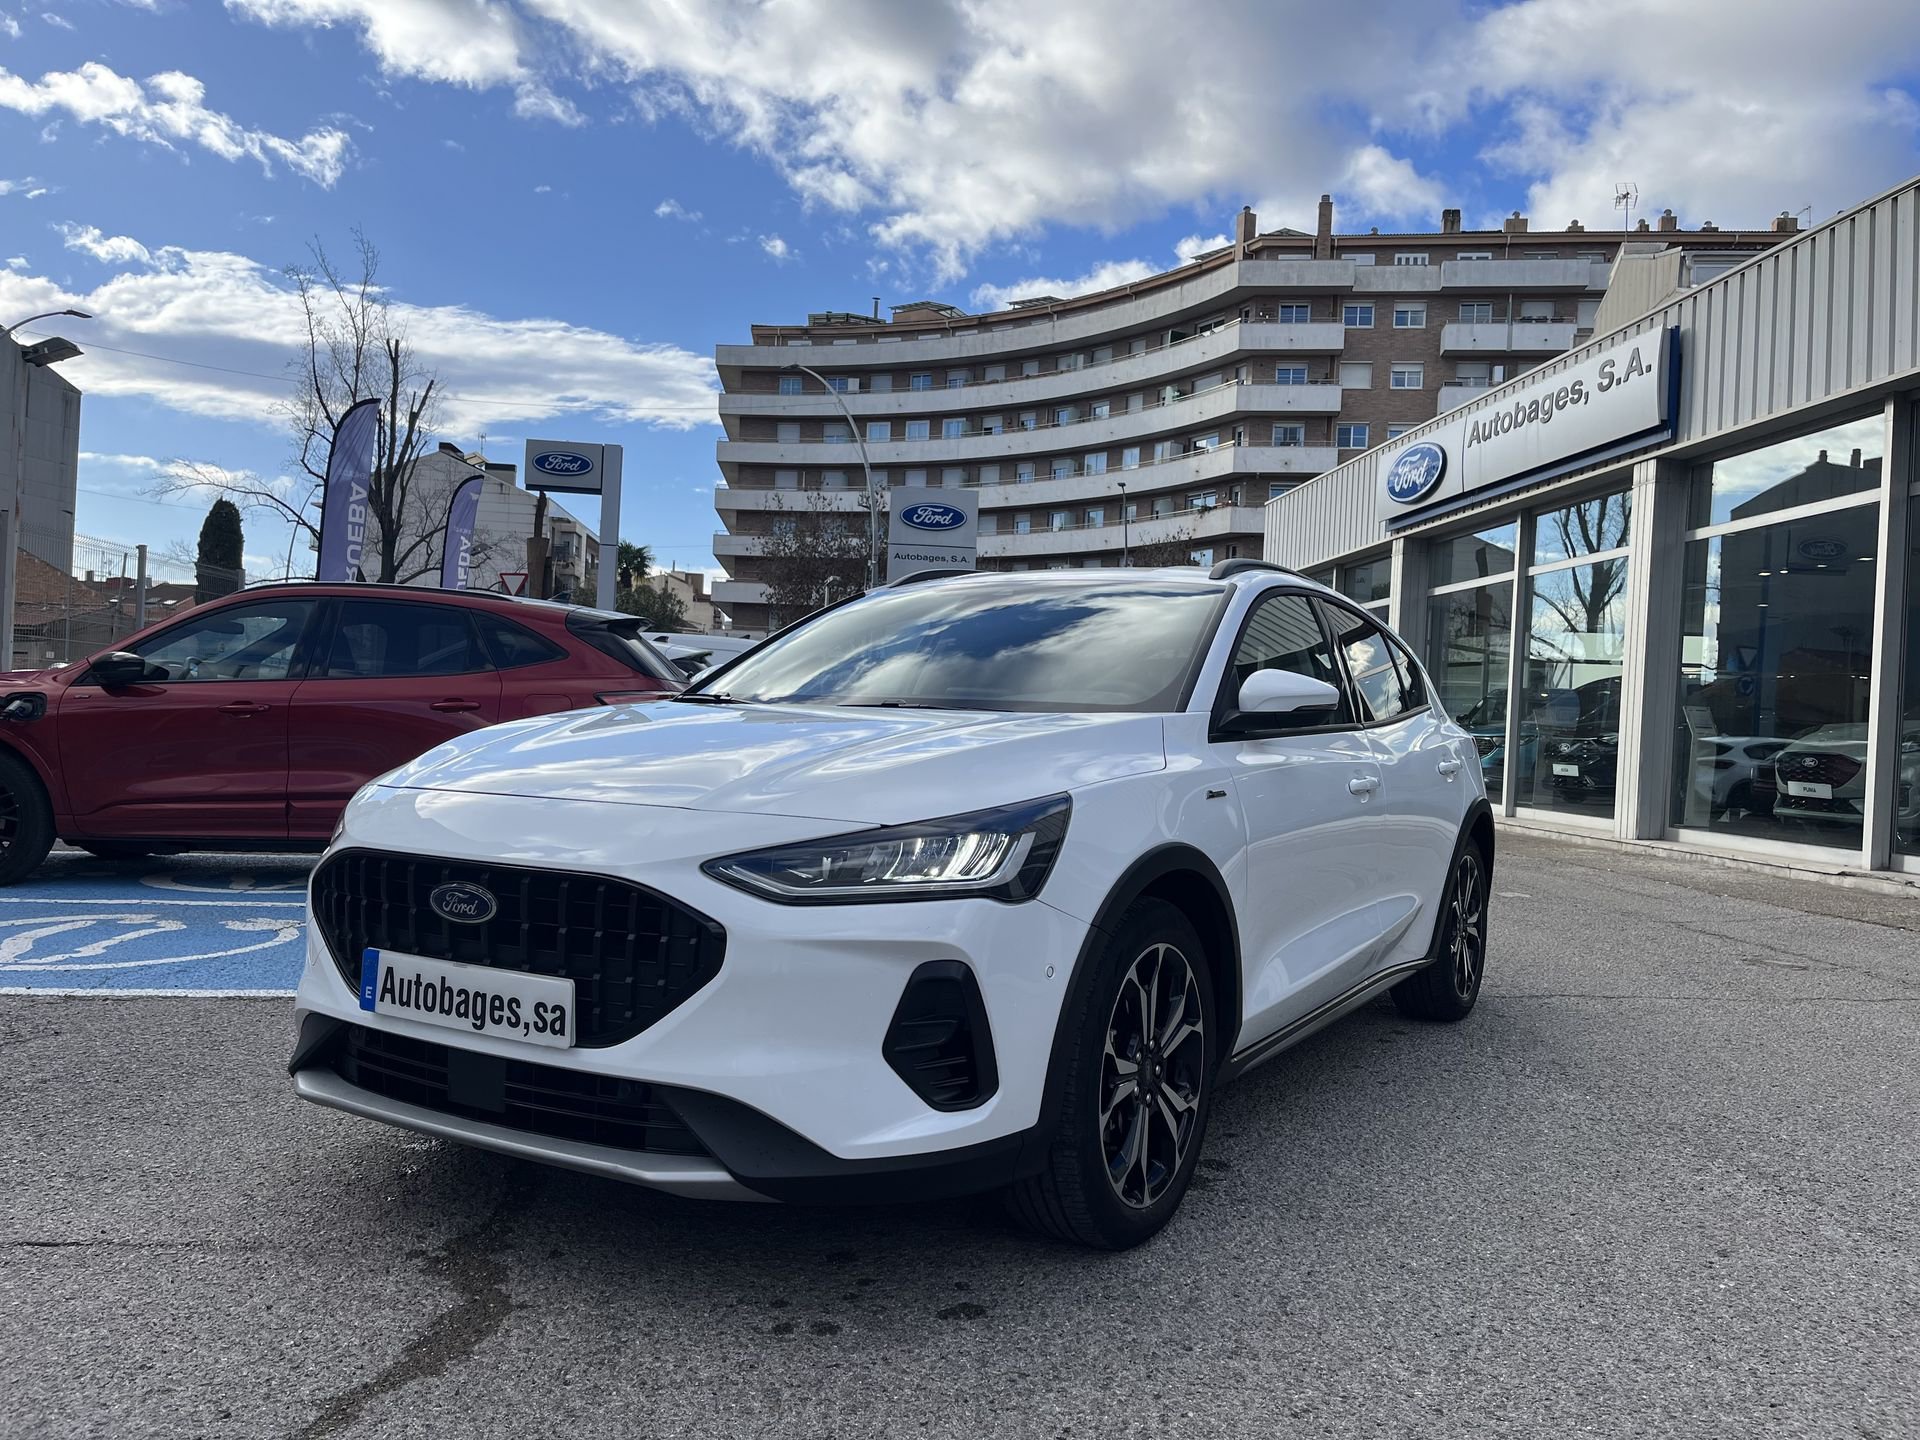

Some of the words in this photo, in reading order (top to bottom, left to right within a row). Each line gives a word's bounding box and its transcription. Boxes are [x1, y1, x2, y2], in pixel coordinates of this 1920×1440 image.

[1467, 378, 1590, 448] Autobages,
[1597, 347, 1653, 393] S.A.
[544, 454, 581, 471] Ford
[1394, 454, 1430, 491] Ford
[913, 506, 954, 524] Ford
[894, 552, 949, 564] Autobages,
[950, 555, 971, 563] S.A.
[442, 892, 479, 916] Ford
[365, 986, 373, 999] E
[379, 966, 567, 1038] Autobages,sa
